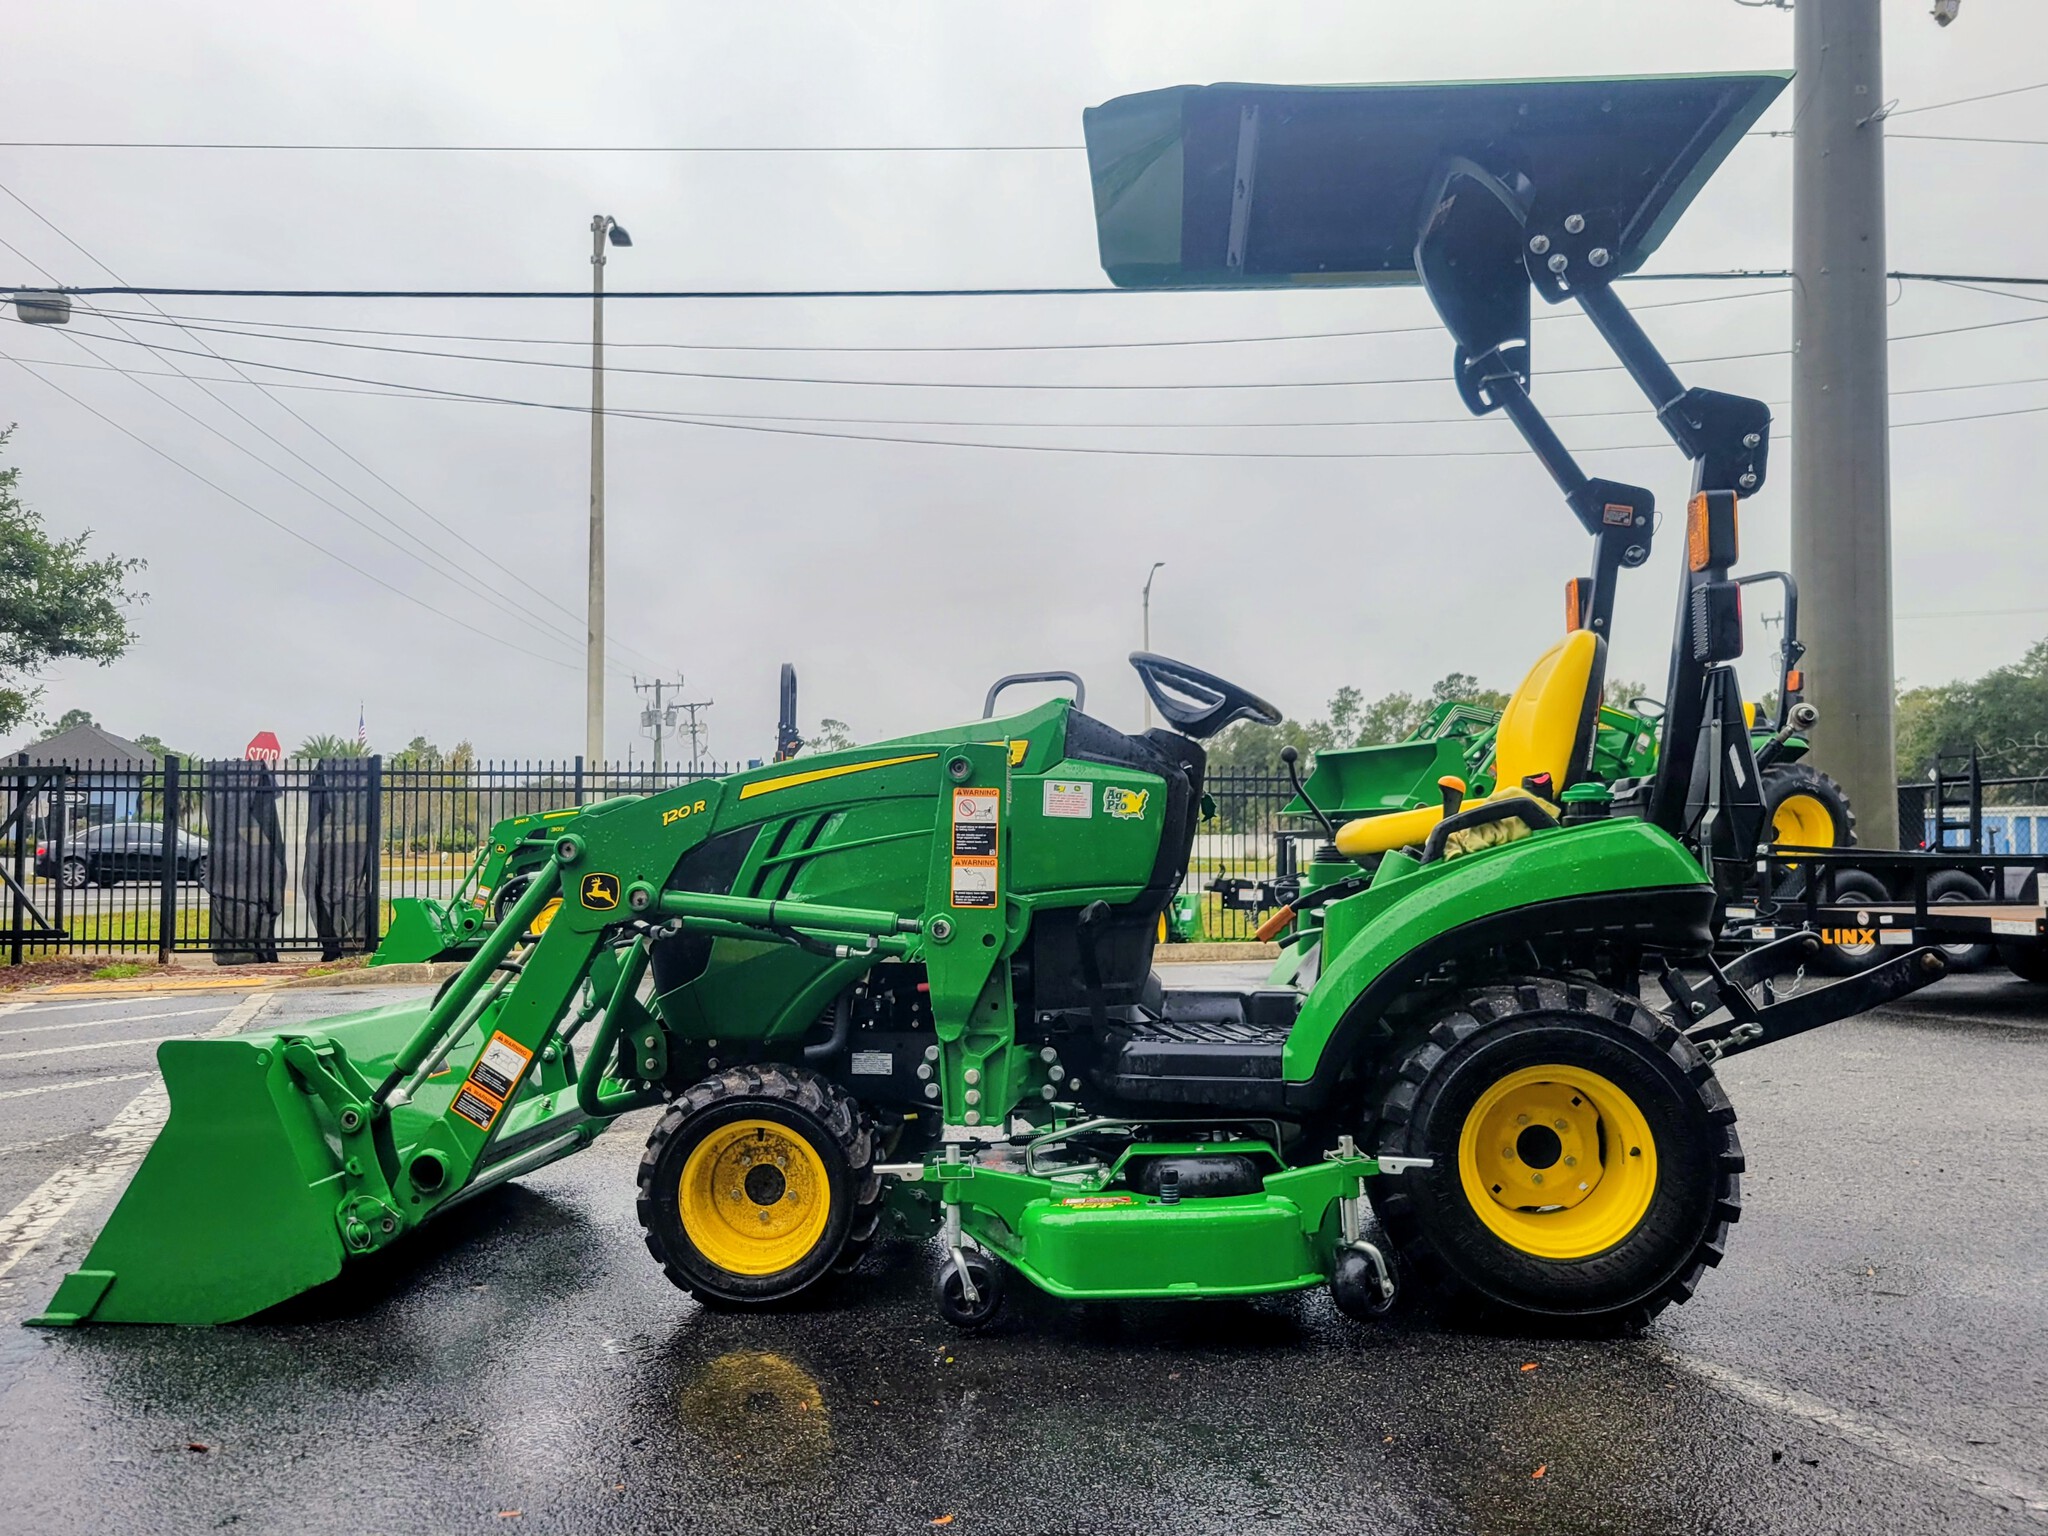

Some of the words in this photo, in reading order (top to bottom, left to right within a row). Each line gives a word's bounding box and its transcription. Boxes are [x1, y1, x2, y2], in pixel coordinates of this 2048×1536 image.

[248, 746, 279, 761] STOP
[662, 804, 692, 826] 120
[693, 798, 706, 815] R
[1107, 800, 1127, 810] Pro
[1821, 928, 1876, 945] LINX
[503, 1038, 527, 1056] WARNING
[474, 1089, 497, 1107] WARNING
